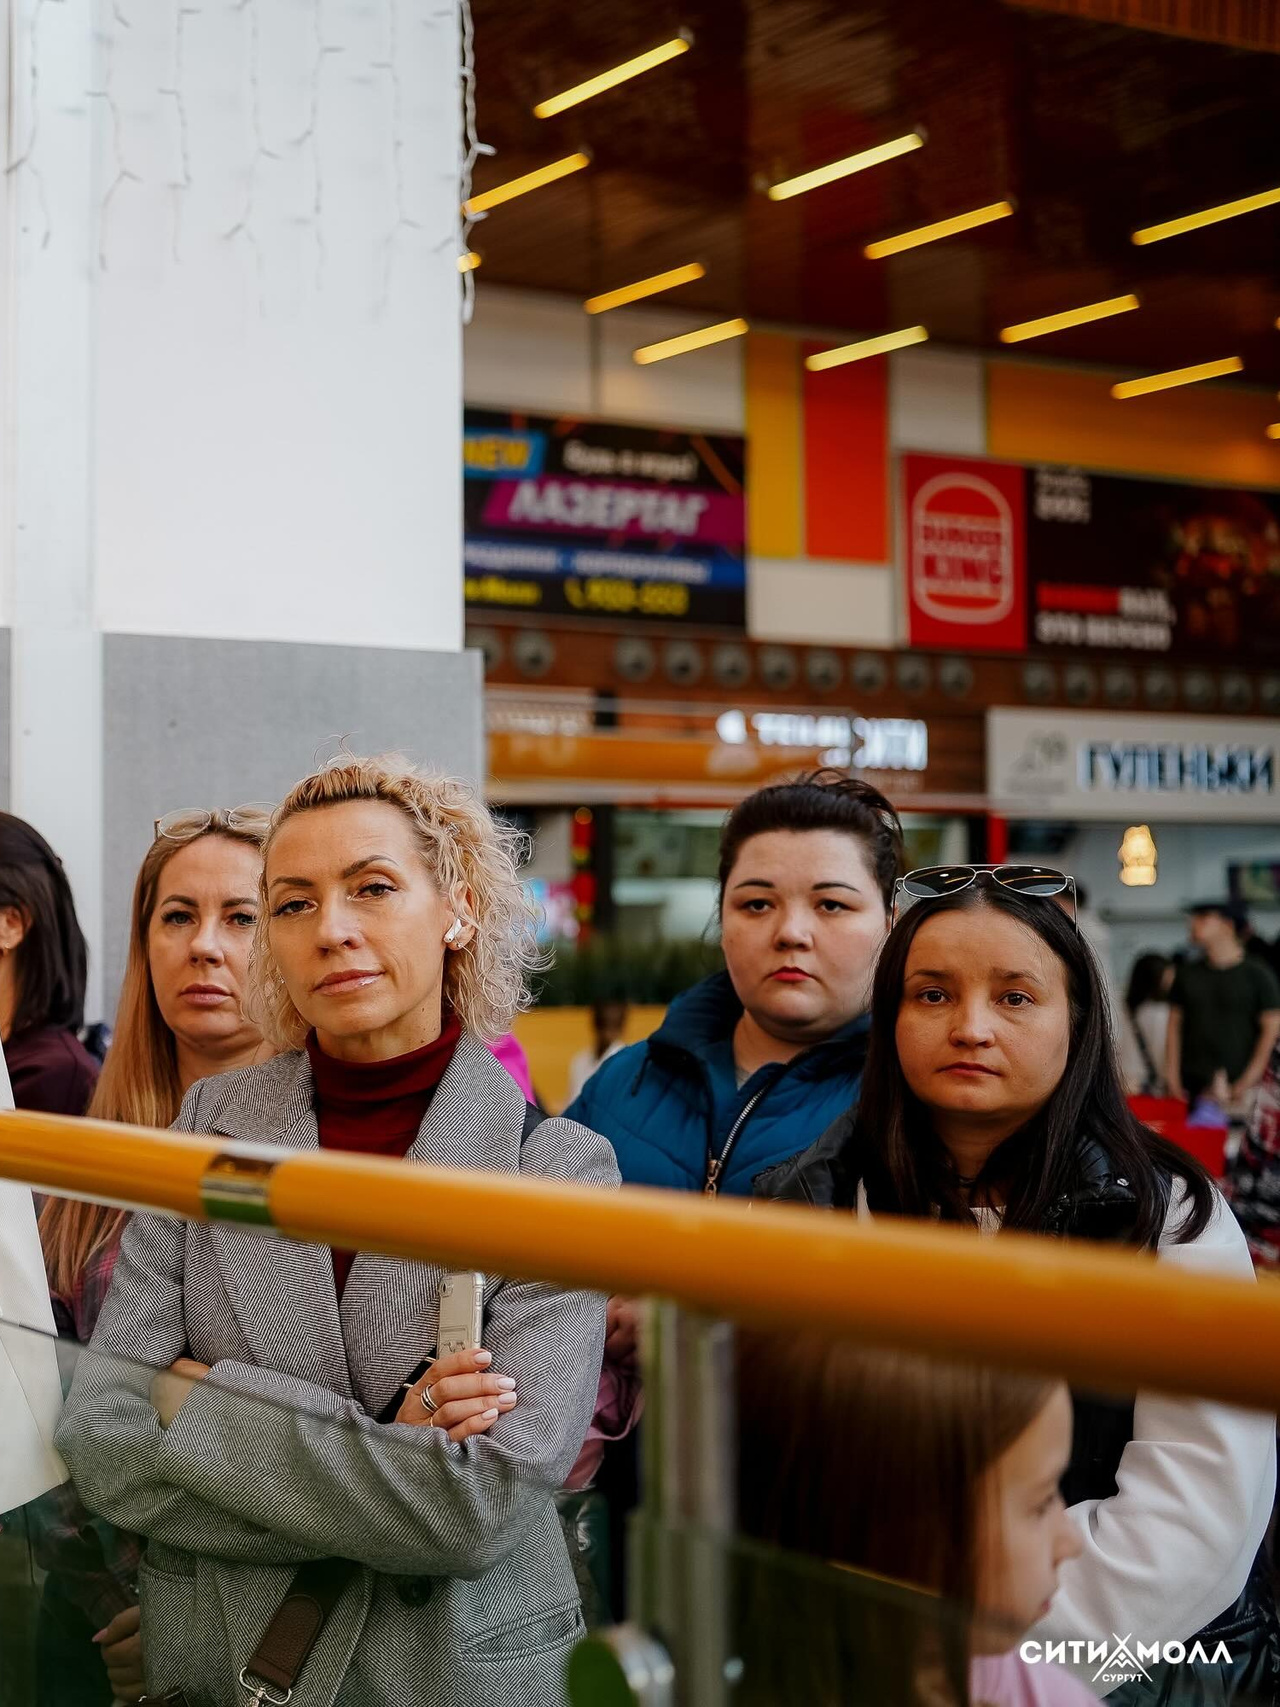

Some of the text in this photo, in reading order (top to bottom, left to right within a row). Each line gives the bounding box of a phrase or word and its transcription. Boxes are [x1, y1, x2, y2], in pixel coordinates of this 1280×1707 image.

[507, 480, 710, 537] ЛАЗЕРТАГ
[923, 553, 1003, 587] KING
[1077, 741, 1273, 793] ГУЛЕНЬКИ
